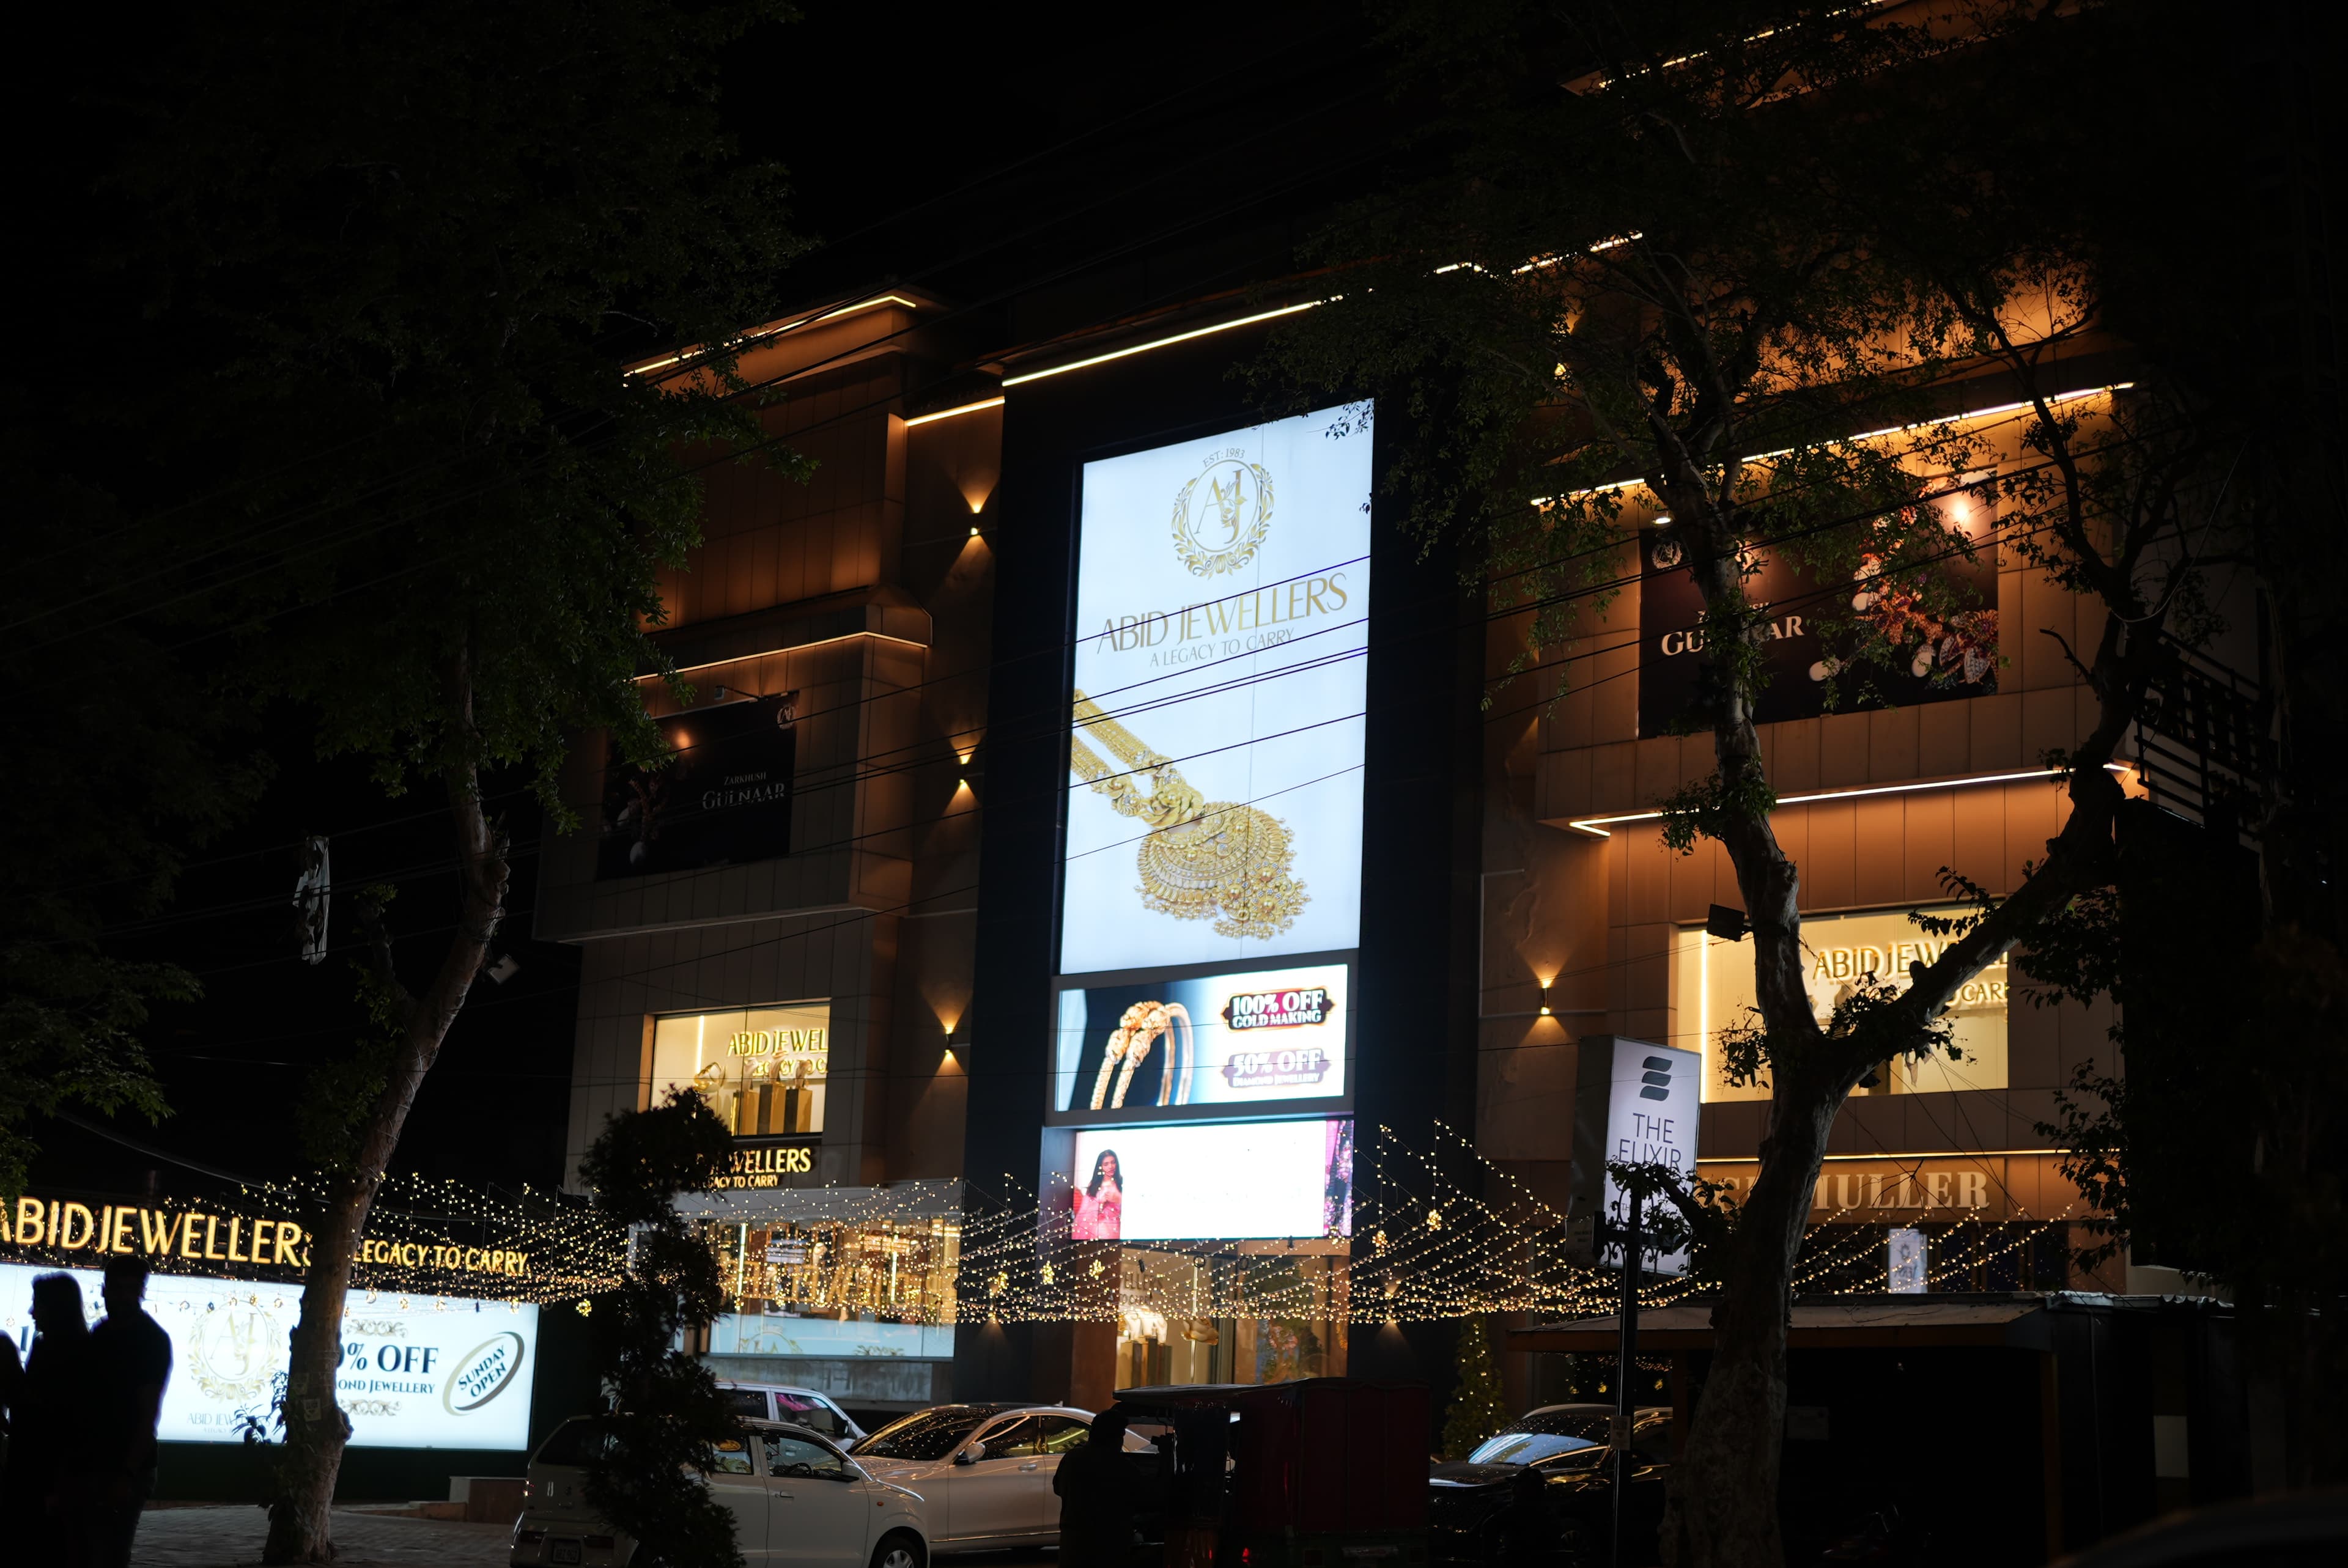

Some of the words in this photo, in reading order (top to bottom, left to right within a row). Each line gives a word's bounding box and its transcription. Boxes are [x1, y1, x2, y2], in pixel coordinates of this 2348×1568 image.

[1203, 451, 1224, 468] EST:
[1225, 447, 1246, 460] 1983
[1097, 610, 1168, 654] ABID
[1176, 572, 1348, 646] JEWELLERS
[1150, 653, 1160, 668] A
[1163, 643, 1216, 666] LEGACY
[1222, 639, 1241, 655] TO
[1246, 627, 1295, 650] CARRY
[702, 782, 786, 810] GULNAAR
[1813, 946, 1884, 981] ABID
[1232, 993, 1279, 1016] 100%
[1282, 990, 1324, 1012] OFF
[1232, 1014, 1269, 1029] GOLD
[1270, 1009, 1321, 1026] MAKING
[727, 1031, 771, 1058] ABID
[1233, 1052, 1274, 1077] 50%
[1277, 1049, 1321, 1073] OFF
[1633, 1113, 1674, 1144] THE
[1619, 1138, 1682, 1174] ELIXIR
[733, 1175, 746, 1188] TO
[747, 1174, 780, 1188] CARRY
[96, 1205, 312, 1267] JEWELLER
[434, 1245, 460, 1270] TO
[465, 1247, 530, 1278] CARRY
[377, 1345, 440, 1374] OFF
[458, 1345, 506, 1390] SUNDAY
[369, 1379, 435, 1394] JEWELLERY
[470, 1362, 507, 1397] OPEN
[186, 1413, 213, 1425] ABID
